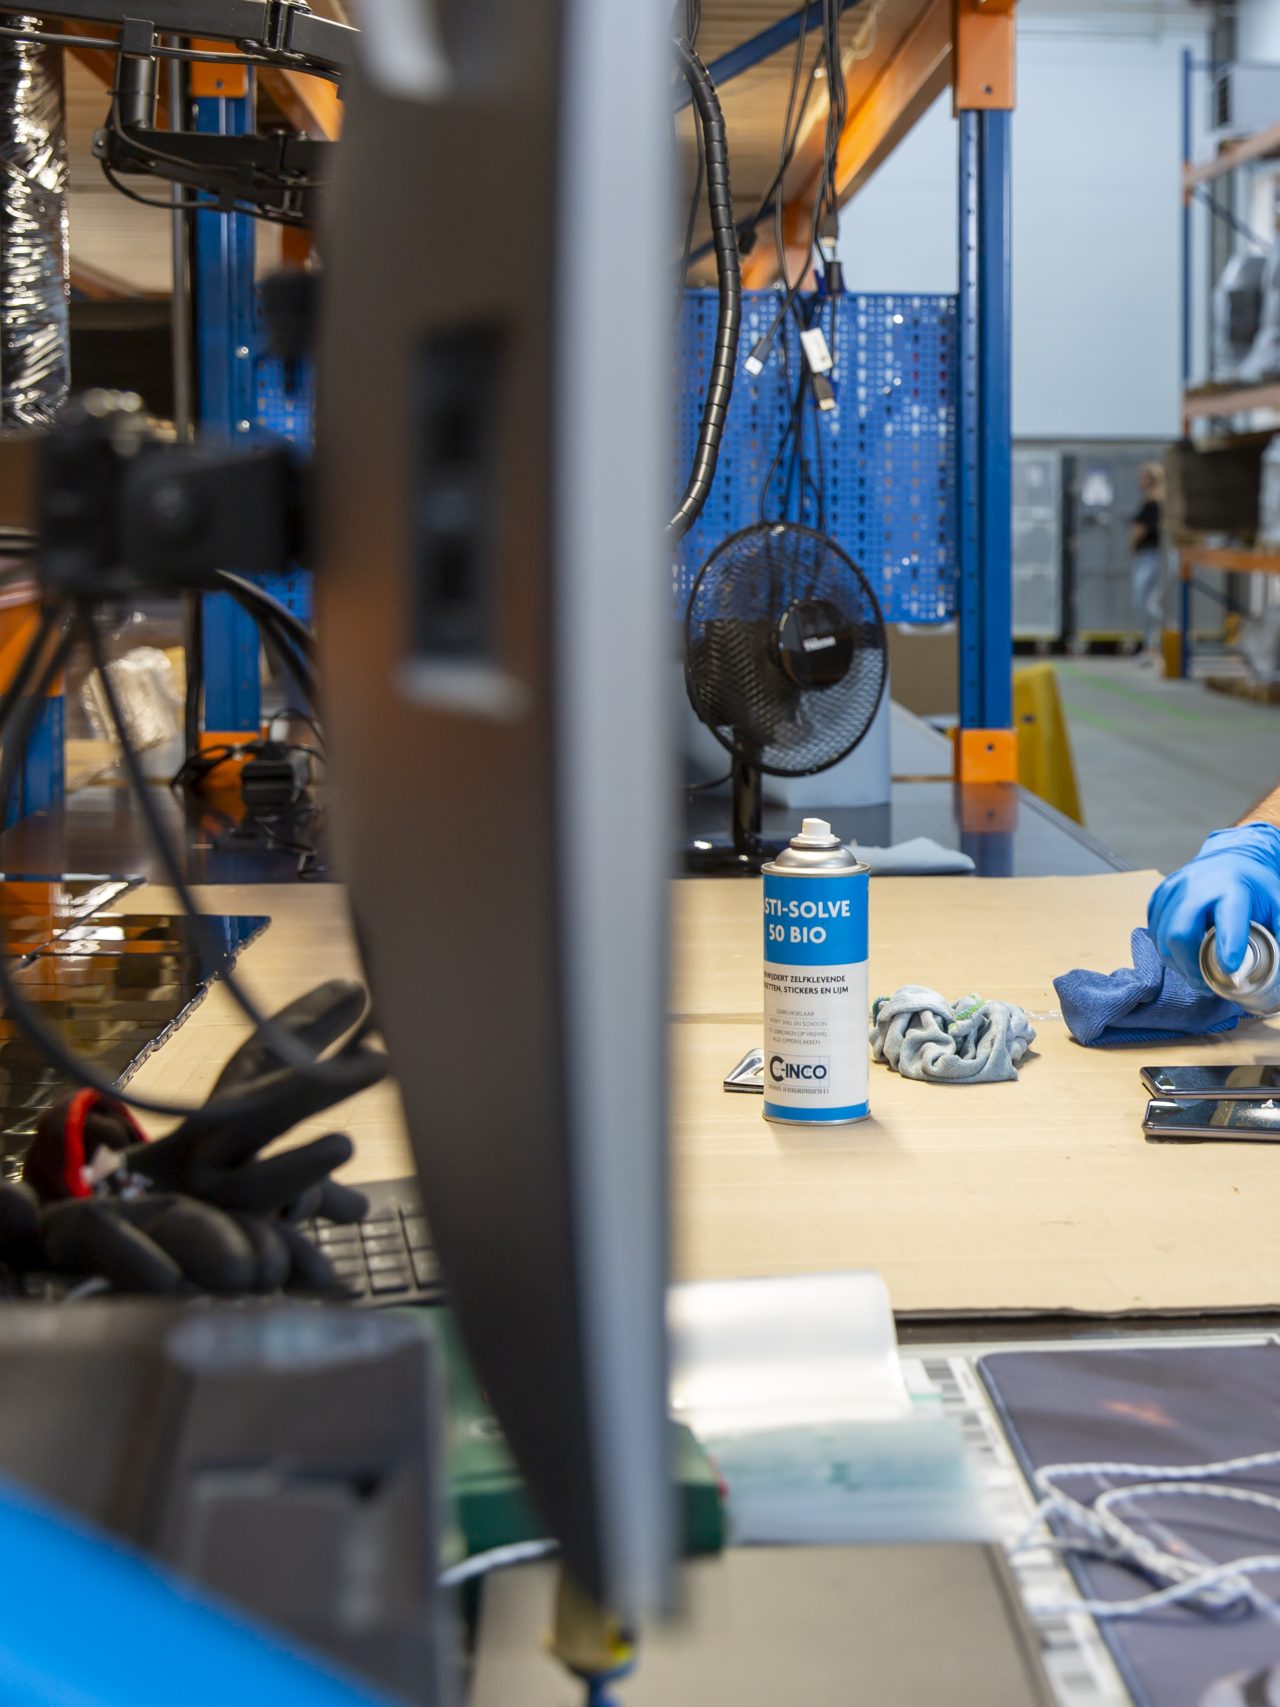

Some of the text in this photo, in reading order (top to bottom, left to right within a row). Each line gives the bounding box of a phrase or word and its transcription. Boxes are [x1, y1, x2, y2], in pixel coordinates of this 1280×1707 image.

[769, 923, 827, 944] 50 BIO
[789, 974, 846, 984] ZELFKLEVENDE
[783, 985, 819, 995] STICKERS
[820, 986, 832, 995] EN
[832, 985, 849, 995] LIJM
